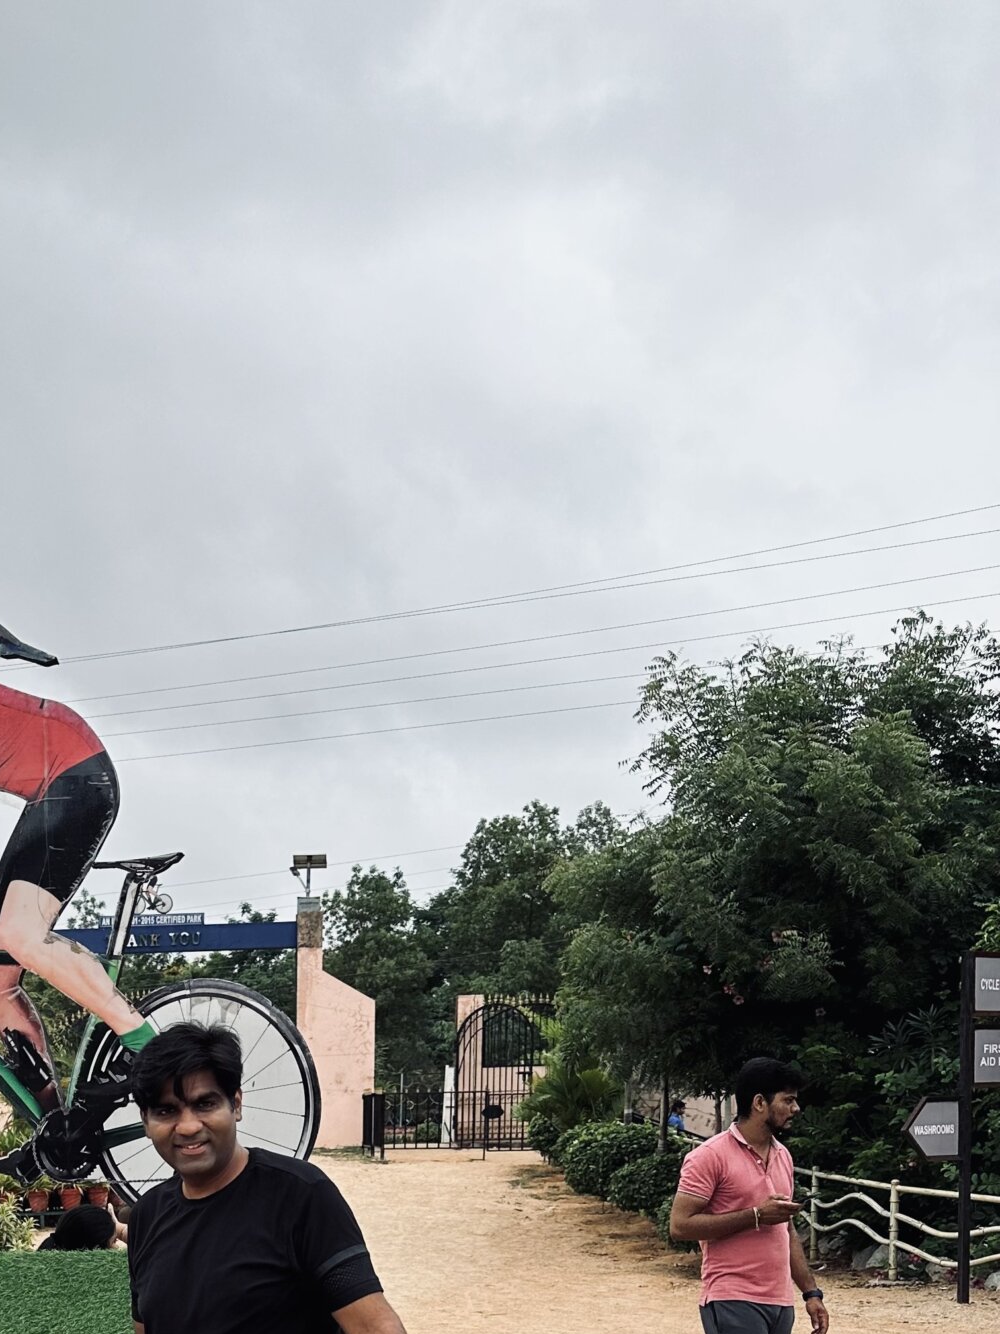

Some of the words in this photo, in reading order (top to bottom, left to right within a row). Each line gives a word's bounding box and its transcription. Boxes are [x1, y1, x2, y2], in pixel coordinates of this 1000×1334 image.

[157, 915, 185, 924] CERTIFIED
[186, 913, 202, 923] PARK
[169, 931, 201, 945] YOU
[980, 978, 1000, 990] CYCLE
[980, 1056, 996, 1066] AID
[913, 1124, 955, 1135] WASHROOMS
